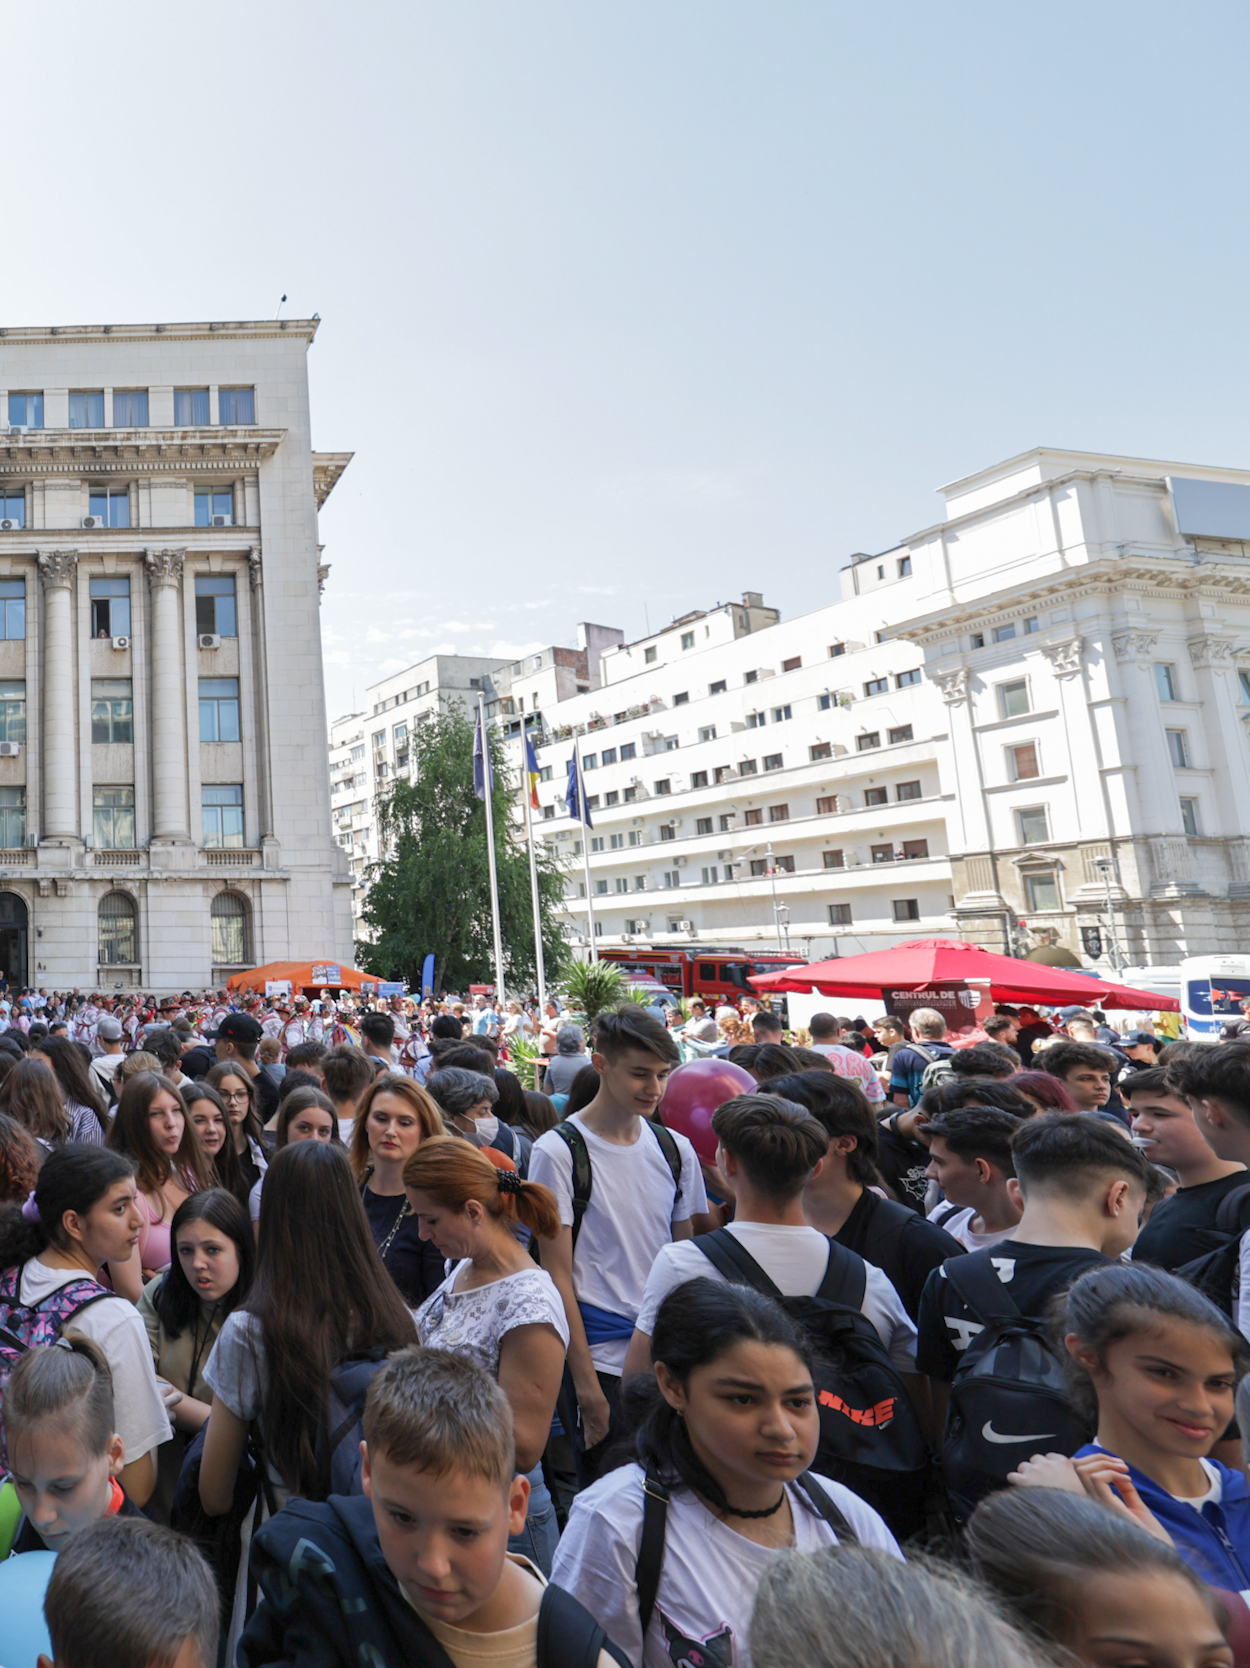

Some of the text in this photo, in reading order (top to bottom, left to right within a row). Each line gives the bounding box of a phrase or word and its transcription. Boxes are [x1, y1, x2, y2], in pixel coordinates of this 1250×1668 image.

[891, 991, 955, 999] CENTRUL DE
[817, 1389, 896, 1427] NIKE
